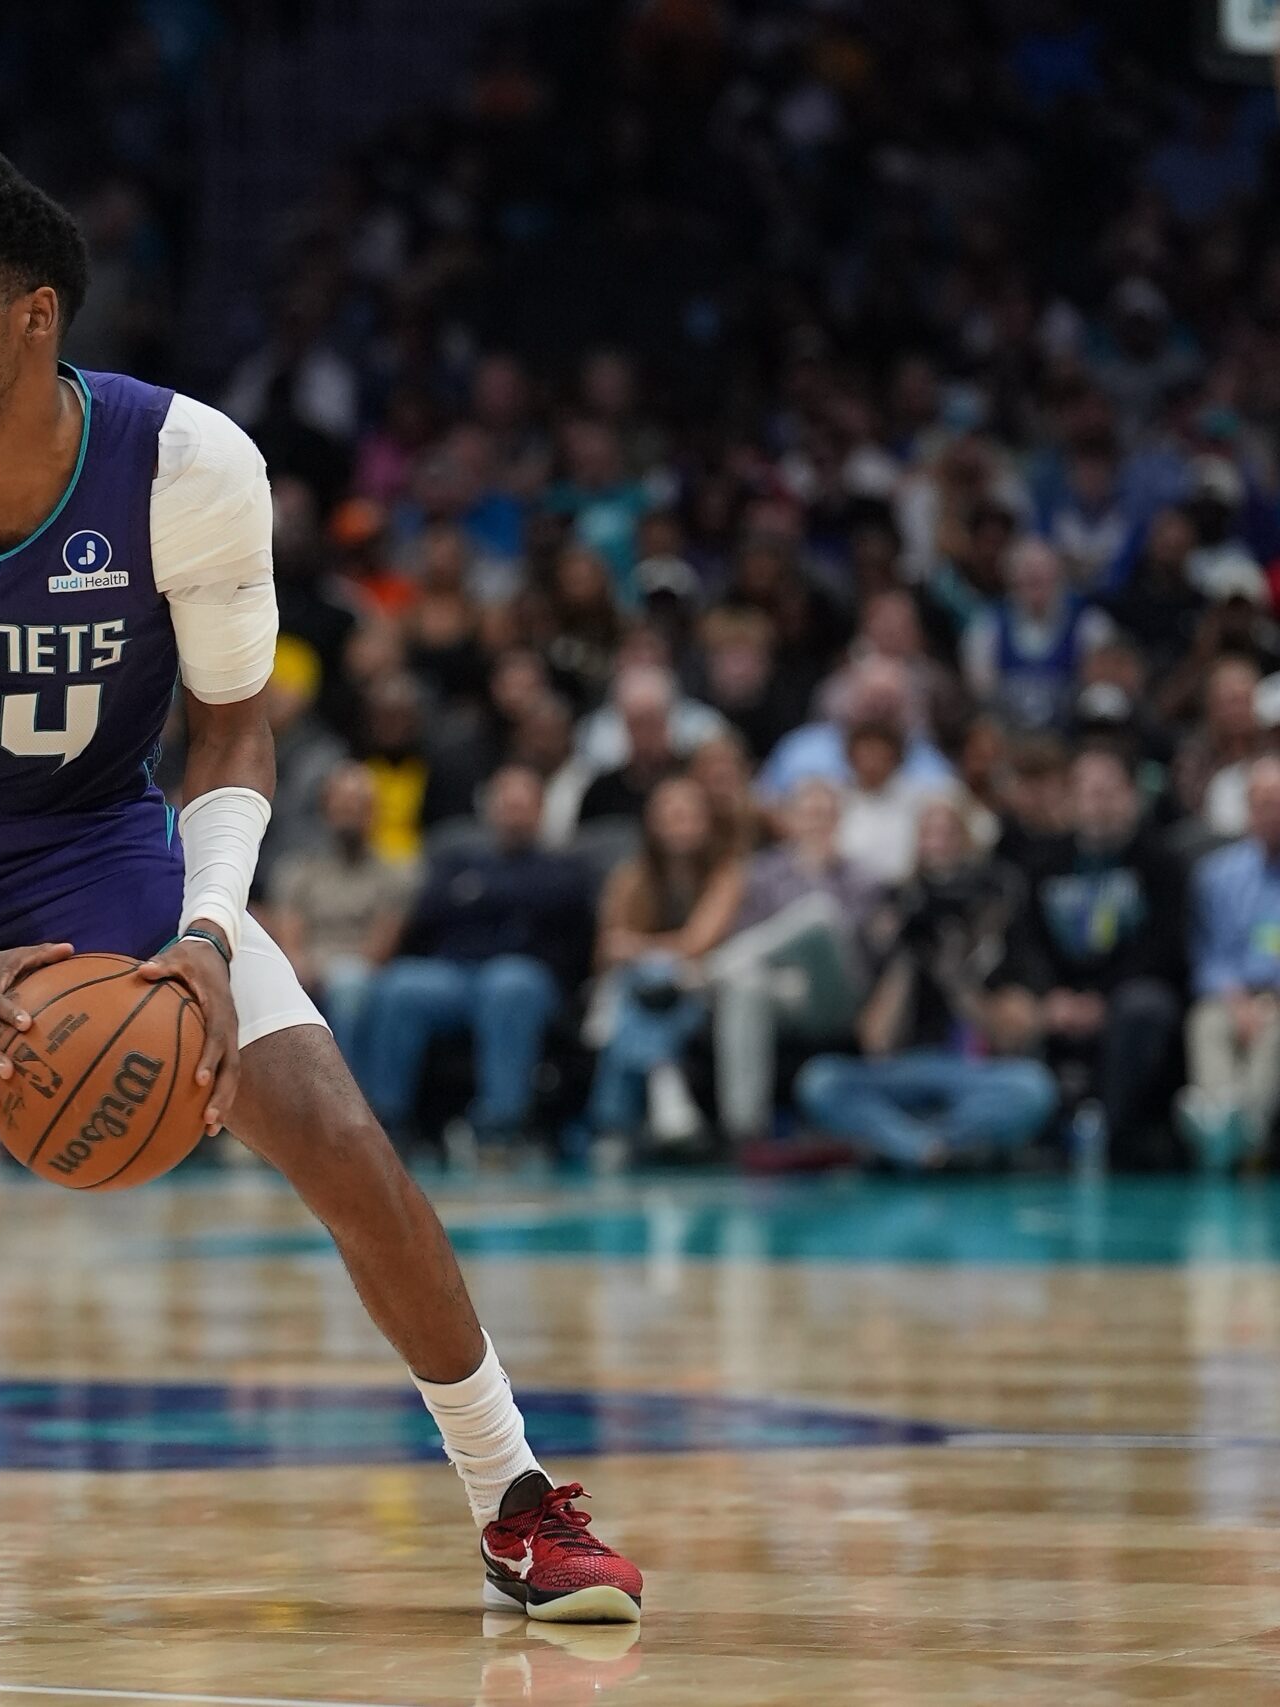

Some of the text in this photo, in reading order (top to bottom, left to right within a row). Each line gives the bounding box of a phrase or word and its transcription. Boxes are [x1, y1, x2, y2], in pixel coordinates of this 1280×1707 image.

[52, 573, 127, 590] Judi Health
[47, 1050, 165, 1175] Wilson
